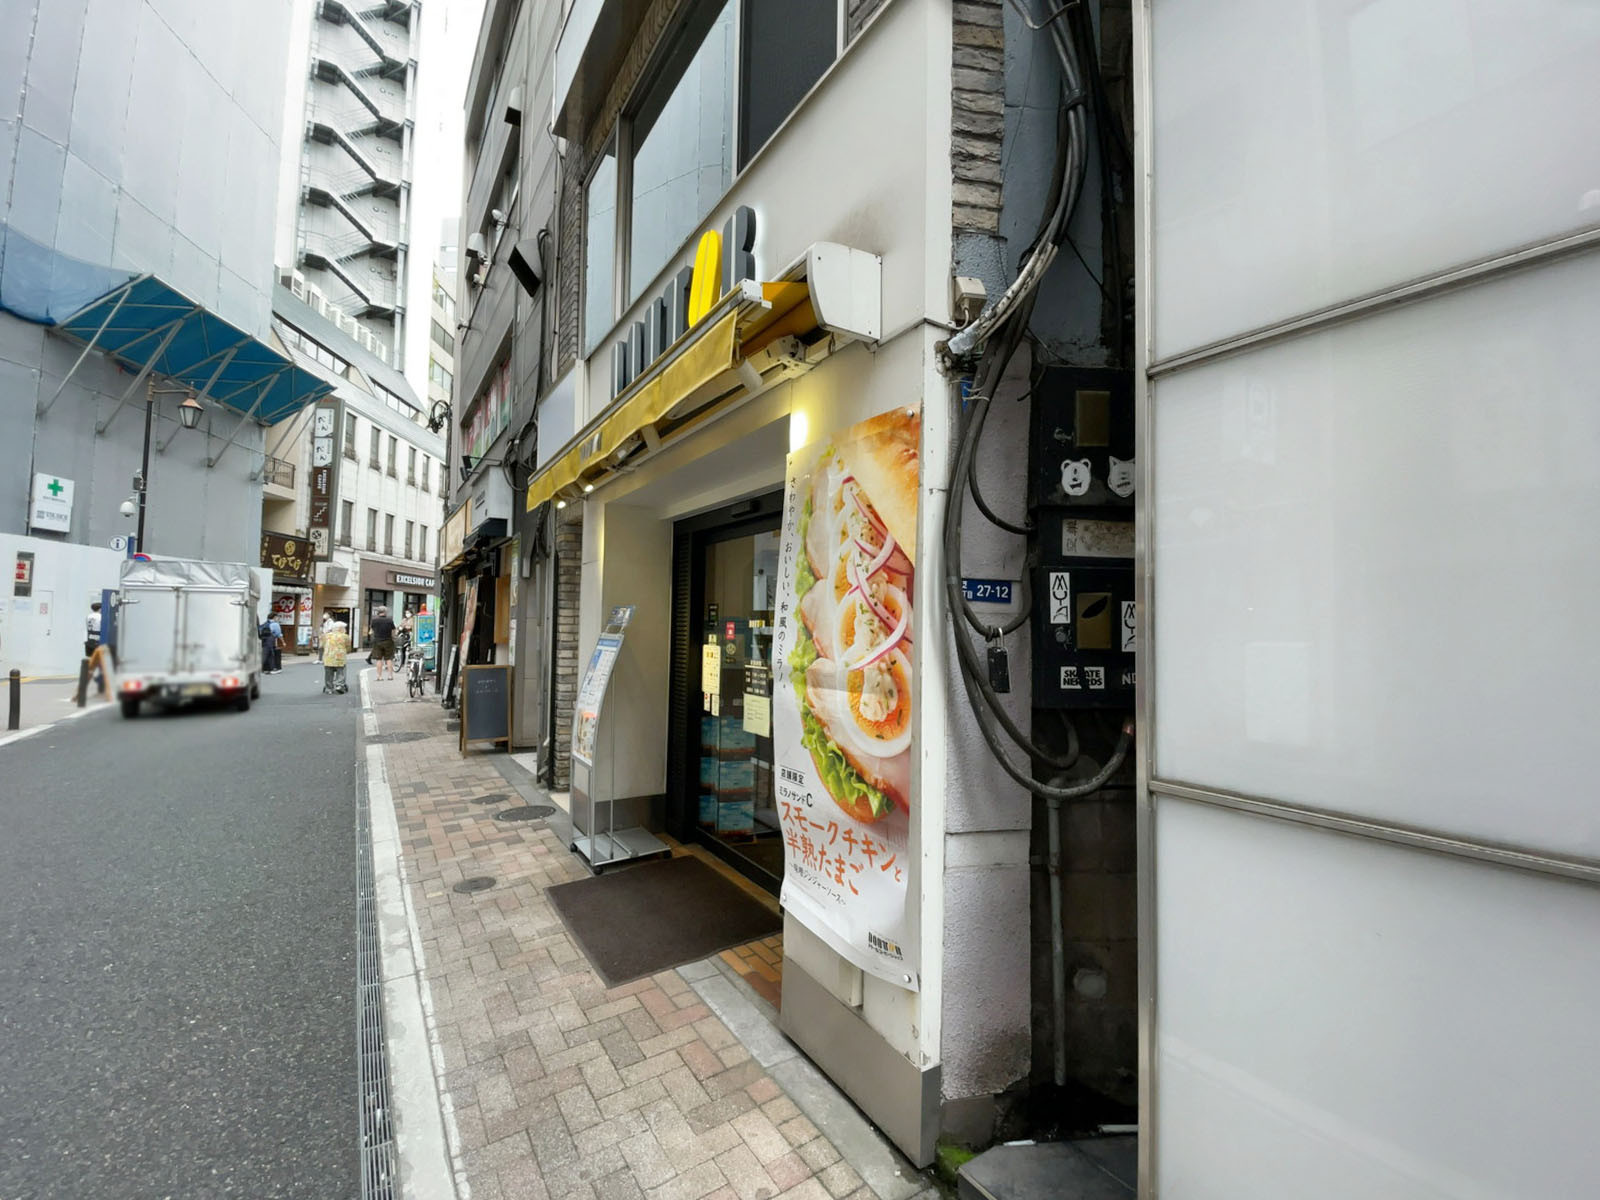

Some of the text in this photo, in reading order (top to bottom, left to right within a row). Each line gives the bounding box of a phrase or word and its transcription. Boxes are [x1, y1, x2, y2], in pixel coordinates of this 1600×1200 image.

[396, 574, 425, 586] EXCELSIOR
[976, 584, 1009, 599] 27-12
[781, 801, 902, 883] スモークチキンと
[785, 826, 864, 896] 半熟たまご
